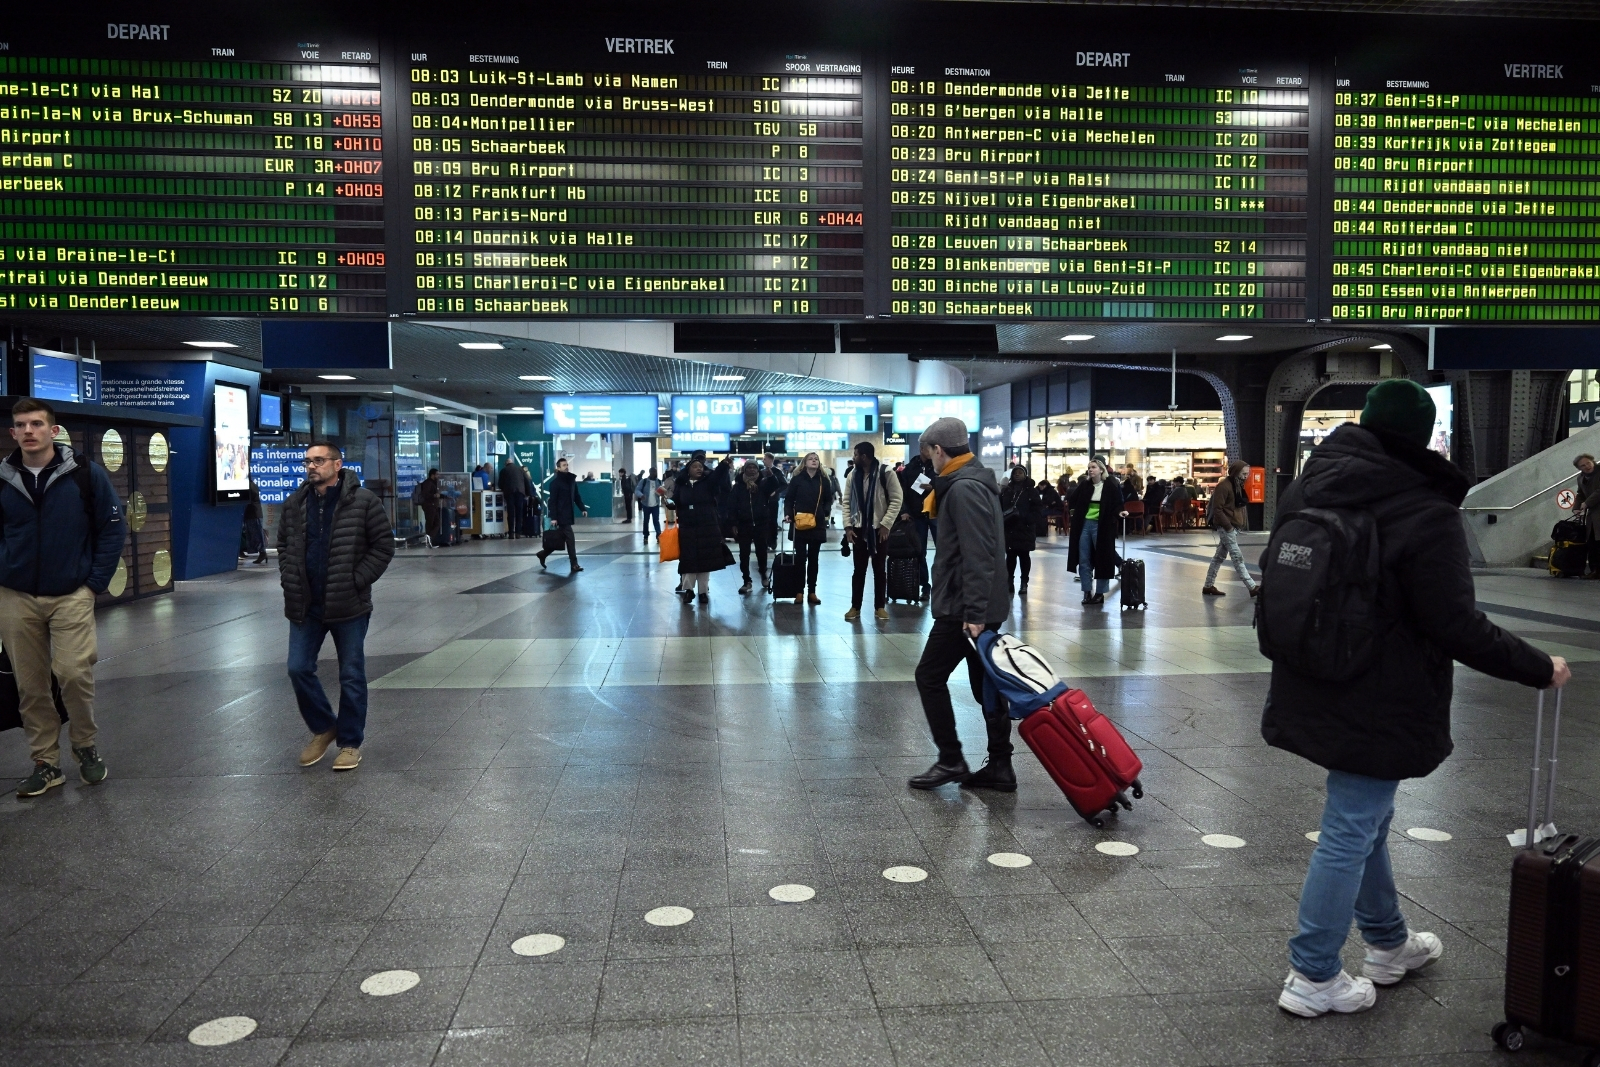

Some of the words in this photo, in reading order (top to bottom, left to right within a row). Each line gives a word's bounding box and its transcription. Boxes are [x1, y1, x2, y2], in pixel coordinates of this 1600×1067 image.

[107, 23, 171, 41] DEPART
[211, 47, 235, 57] TRAIN
[604, 37, 675, 55] VERTREK
[301, 50, 320, 59] VOIE
[341, 51, 372, 60] RETARD
[411, 53, 428, 62] UUR
[469, 54, 520, 64] BESTEMMING
[1076, 51, 1131, 68] DEPART
[706, 60, 728, 70] TREIN
[785, 63, 811, 72] SPOOR
[815, 64, 862, 74] VERTRAGING
[891, 65, 915, 75] HEURE
[944, 67, 991, 77] DESTINATION
[1503, 63, 1564, 80] VERTREK
[412, 69, 458, 82] 08:03
[470, 71, 583, 86] Luik-St-Lamb
[595, 74, 621, 86] via
[632, 75, 677, 88] Namen
[1164, 74, 1185, 82] TRAIN
[1241, 76, 1258, 84] VOIE
[1276, 76, 1303, 85] RETARD
[1336, 79, 1350, 87] UUR
[1386, 80, 1430, 89] BESTEMMING
[0, 82, 78, 97] ne-le-Ct
[92, 85, 120, 97] via
[132, 85, 159, 98] Hal
[273, 89, 291, 102] S2
[303, 90, 321, 103] 20
[892, 81, 934, 94] 08:18
[946, 82, 1041, 97] Dendermonde
[1052, 86, 1076, 98] via
[1087, 87, 1128, 99] Jette
[412, 93, 459, 105] 08:03
[471, 94, 574, 108] Dendermonde
[586, 97, 612, 109] via
[623, 97, 713, 111] Bruss-West
[754, 100, 779, 113] S10
[1336, 93, 1376, 105] 08:37
[1386, 94, 1459, 107] Gent-St-P
[1, 106, 80, 120] ain-la-N
[93, 108, 121, 121] via
[133, 109, 252, 124] Brux-Schuman
[274, 113, 292, 125] S8
[305, 113, 321, 126] 13
[334, 114, 380, 127] +0H59
[892, 103, 935, 116] 08:19
[946, 105, 1015, 119] G'bergen
[1025, 107, 1050, 119] via
[1061, 108, 1102, 120] Halle
[413, 116, 460, 130] 08:04
[471, 117, 574, 132] Montpellier
[754, 123, 779, 135] TGV
[1336, 115, 1376, 127] 08:38
[1386, 116, 1475, 130] Antwerpen-C
[1485, 118, 1507, 129] via
[1517, 119, 1580, 131] Mechelen
[2, 130, 69, 145] Airport
[275, 136, 293, 148] IC
[306, 137, 322, 149] 18
[335, 138, 381, 150] +0H10
[892, 125, 935, 138] 08:20
[946, 127, 1041, 142] Antwerpen-C
[1052, 130, 1076, 141] via
[1087, 130, 1154, 143] Mechelen
[414, 139, 460, 151] 08:05
[472, 140, 565, 153] Schaarbeek
[1335, 136, 1375, 148] 08:39
[1385, 137, 1450, 151] Kortrijk
[1460, 139, 1482, 150] via
[1492, 139, 1556, 153] Zottegem
[892, 147, 935, 160] 08:23
[946, 149, 970, 161] Bru
[981, 150, 1039, 163] Airport
[2, 154, 52, 166] erdam
[64, 154, 72, 167] C
[266, 159, 293, 172] EUR
[336, 161, 381, 173] +0H07
[414, 161, 461, 174] 08:09
[472, 163, 499, 175] Bru
[510, 163, 574, 178] Airport
[1335, 158, 1375, 169] 08:40
[1385, 158, 1408, 170] Bru
[1418, 159, 1472, 172] Airport
[892, 169, 935, 182] 08:24
[945, 171, 1023, 184] Gent-St-P
[1034, 173, 1058, 185] via
[1069, 173, 1109, 186] Aalst
[415, 185, 461, 197] 08:12
[473, 185, 555, 198] Frankfurt
[568, 187, 585, 199] Hb
[755, 190, 780, 202] ICE
[892, 192, 935, 204] 08:25
[946, 193, 995, 207] Nijvel
[1008, 194, 1032, 206] via
[1043, 195, 1135, 208] Eigenbrakel
[1334, 200, 1374, 212] 08:44
[1384, 201, 1473, 213] Dendermonde
[1483, 202, 1506, 213] via
[1515, 202, 1554, 214] Jette
[415, 208, 462, 220] 08:13
[473, 208, 566, 221] Paris-Nord
[755, 212, 780, 224] EUR
[818, 212, 863, 225] +0H44
[946, 215, 986, 228] Rijdt
[999, 216, 1058, 230] vandaag
[1069, 217, 1100, 228] niet
[416, 230, 462, 243] 08:14
[474, 231, 538, 244] Doornik
[550, 232, 576, 244] via
[588, 232, 632, 244] Halle
[892, 236, 935, 248] 08:28
[946, 236, 997, 249] Leuven
[1008, 238, 1032, 250] via
[1042, 238, 1127, 251] Schaarbeek
[17, 248, 45, 260] via
[58, 248, 175, 262] Braine-le-Ct
[339, 253, 384, 265] +0H09
[417, 253, 462, 265] 08:15
[474, 253, 567, 267] Schaarbeek
[892, 257, 935, 269] 08:29
[946, 258, 1049, 273] Blankenberge
[1060, 260, 1084, 272] via
[1094, 260, 1170, 273] Gent-St-P
[59, 272, 87, 284] via
[99, 272, 208, 286] Denderleeuw
[417, 276, 463, 288] 08:15
[475, 276, 577, 289] Charleroi-C
[588, 277, 614, 289] via
[626, 278, 724, 291] Eigenbrakel
[85, 381, 92, 397] 5
[1578, 409, 1590, 423] M
[1280, 542, 1313, 556] SUPER
